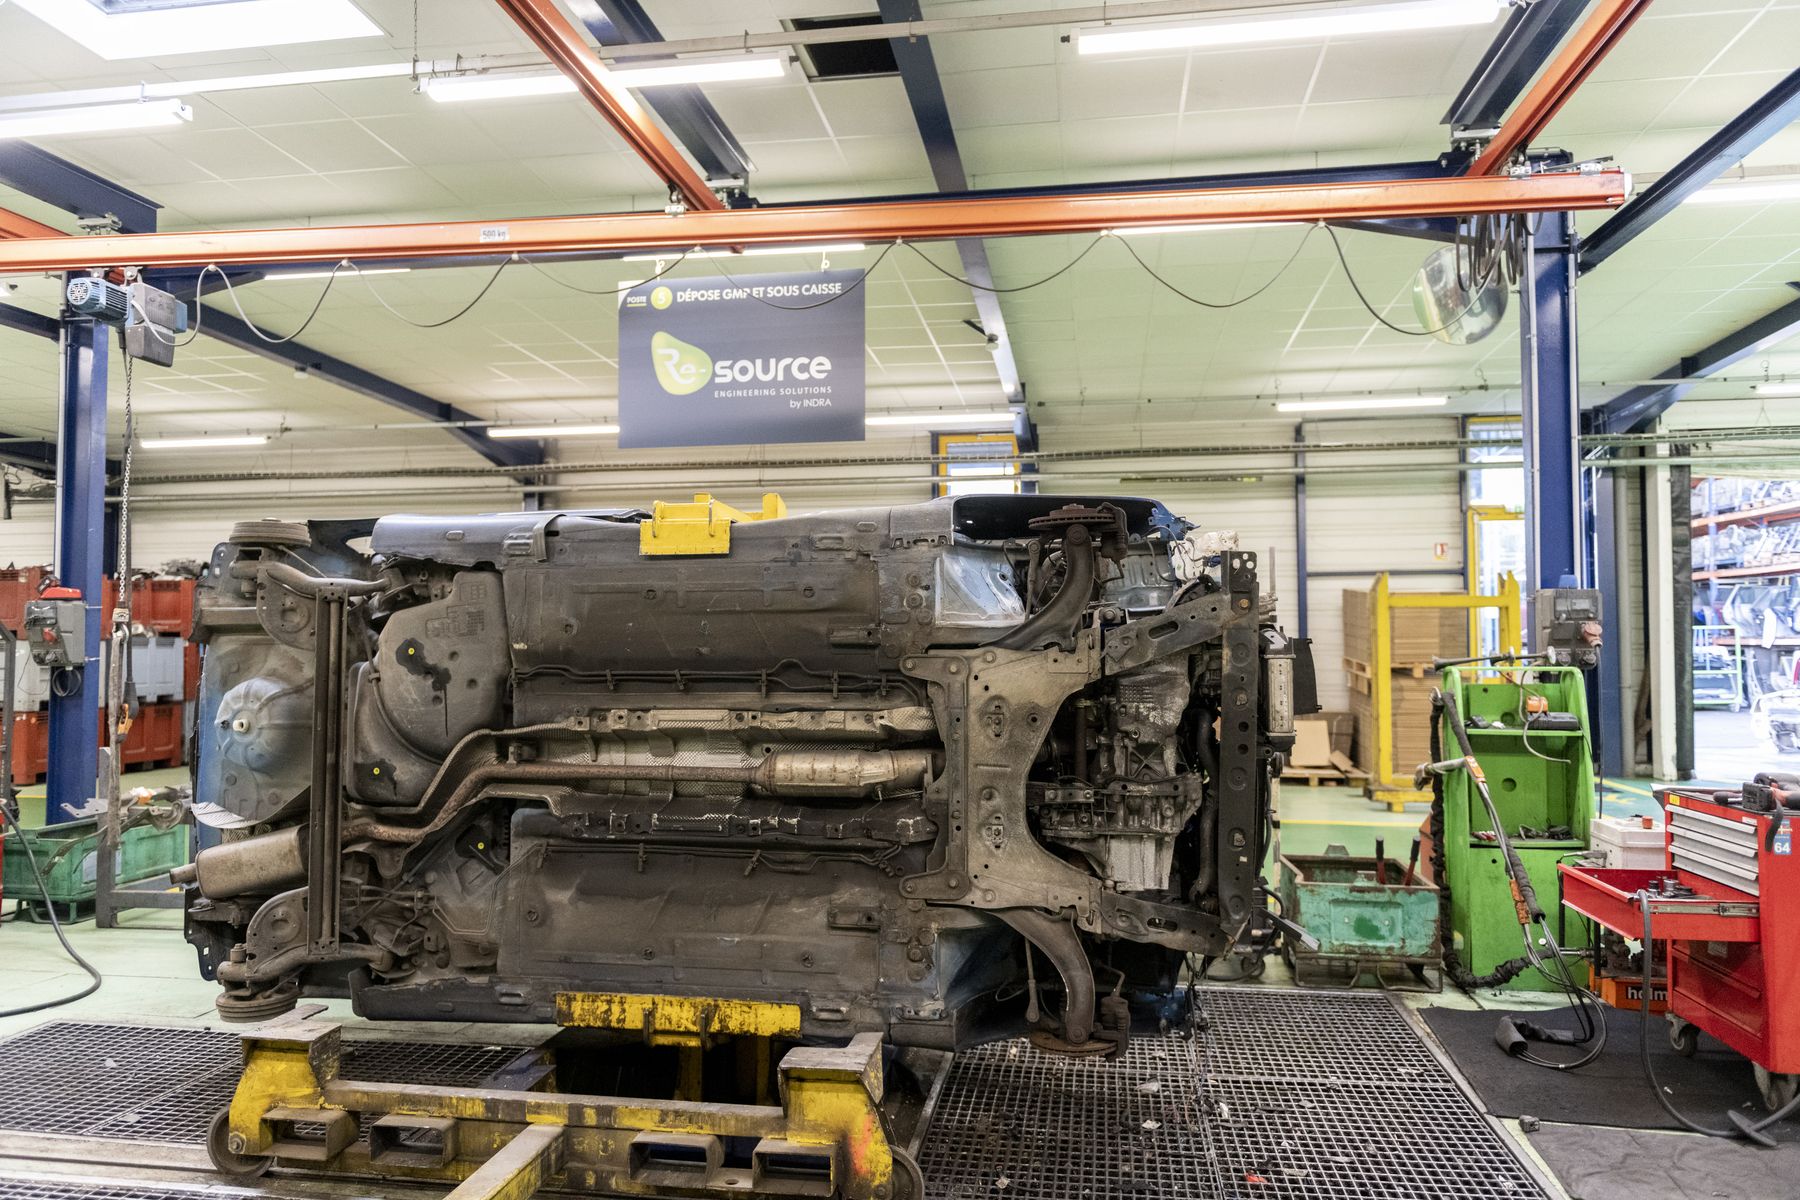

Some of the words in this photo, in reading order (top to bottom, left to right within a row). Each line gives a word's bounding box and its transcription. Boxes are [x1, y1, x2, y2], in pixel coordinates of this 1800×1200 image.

[676, 288, 721, 303] DÉPOSE
[722, 287, 751, 301] GMP
[752, 286, 766, 299] ET
[766, 284, 800, 298] SOUS
[801, 282, 842, 296] CAISSE
[626, 295, 647, 304] POSTE
[714, 388, 776, 398] ENGINEERING
[779, 385, 833, 396] SOLUTIONS
[789, 399, 802, 410] by
[803, 398, 833, 409] INDRA
[1774, 842, 1791, 853] 64
